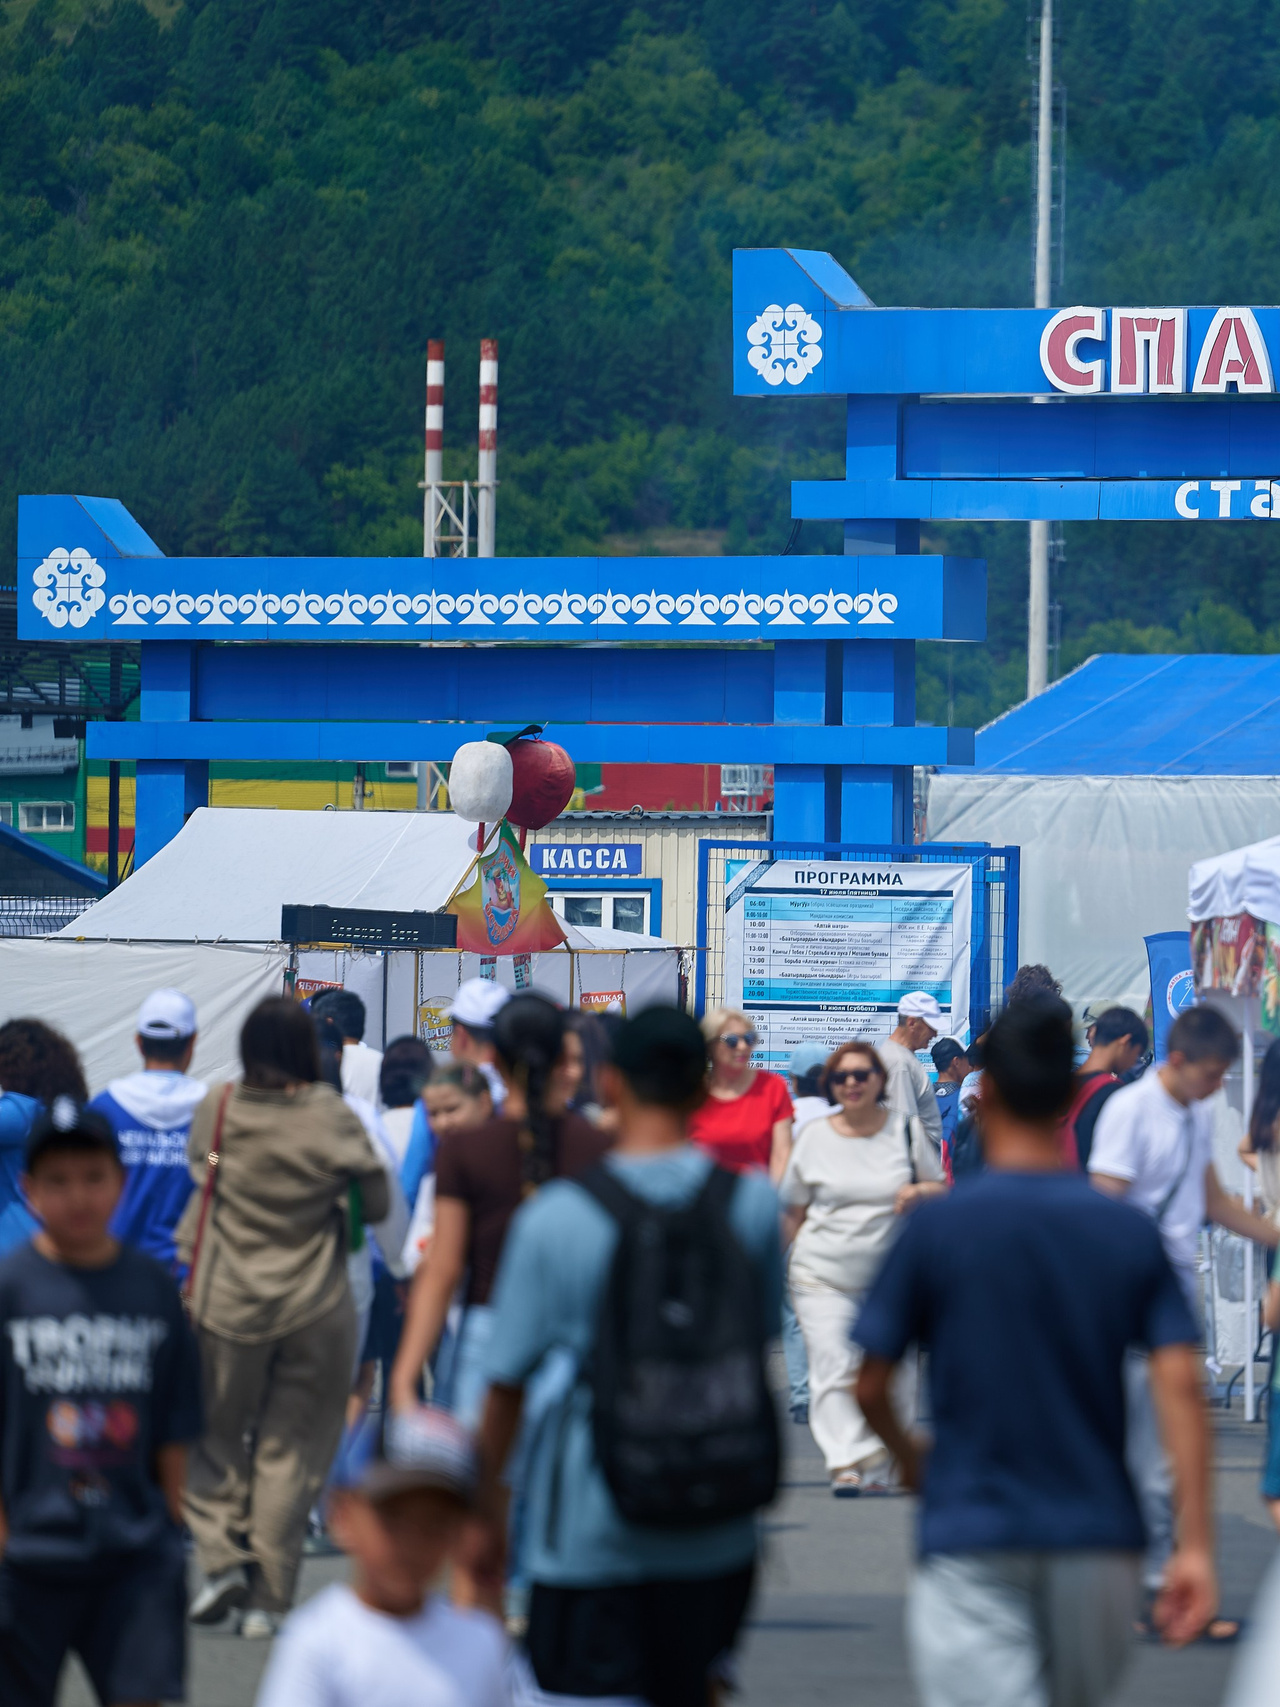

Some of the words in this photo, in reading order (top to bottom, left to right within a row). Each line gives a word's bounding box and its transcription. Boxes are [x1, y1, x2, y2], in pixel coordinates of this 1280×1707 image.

[542, 848, 627, 869] КАССА
[795, 870, 904, 886] ПРОГРАММА
[582, 994, 624, 1004] СЛАДКАЯ
